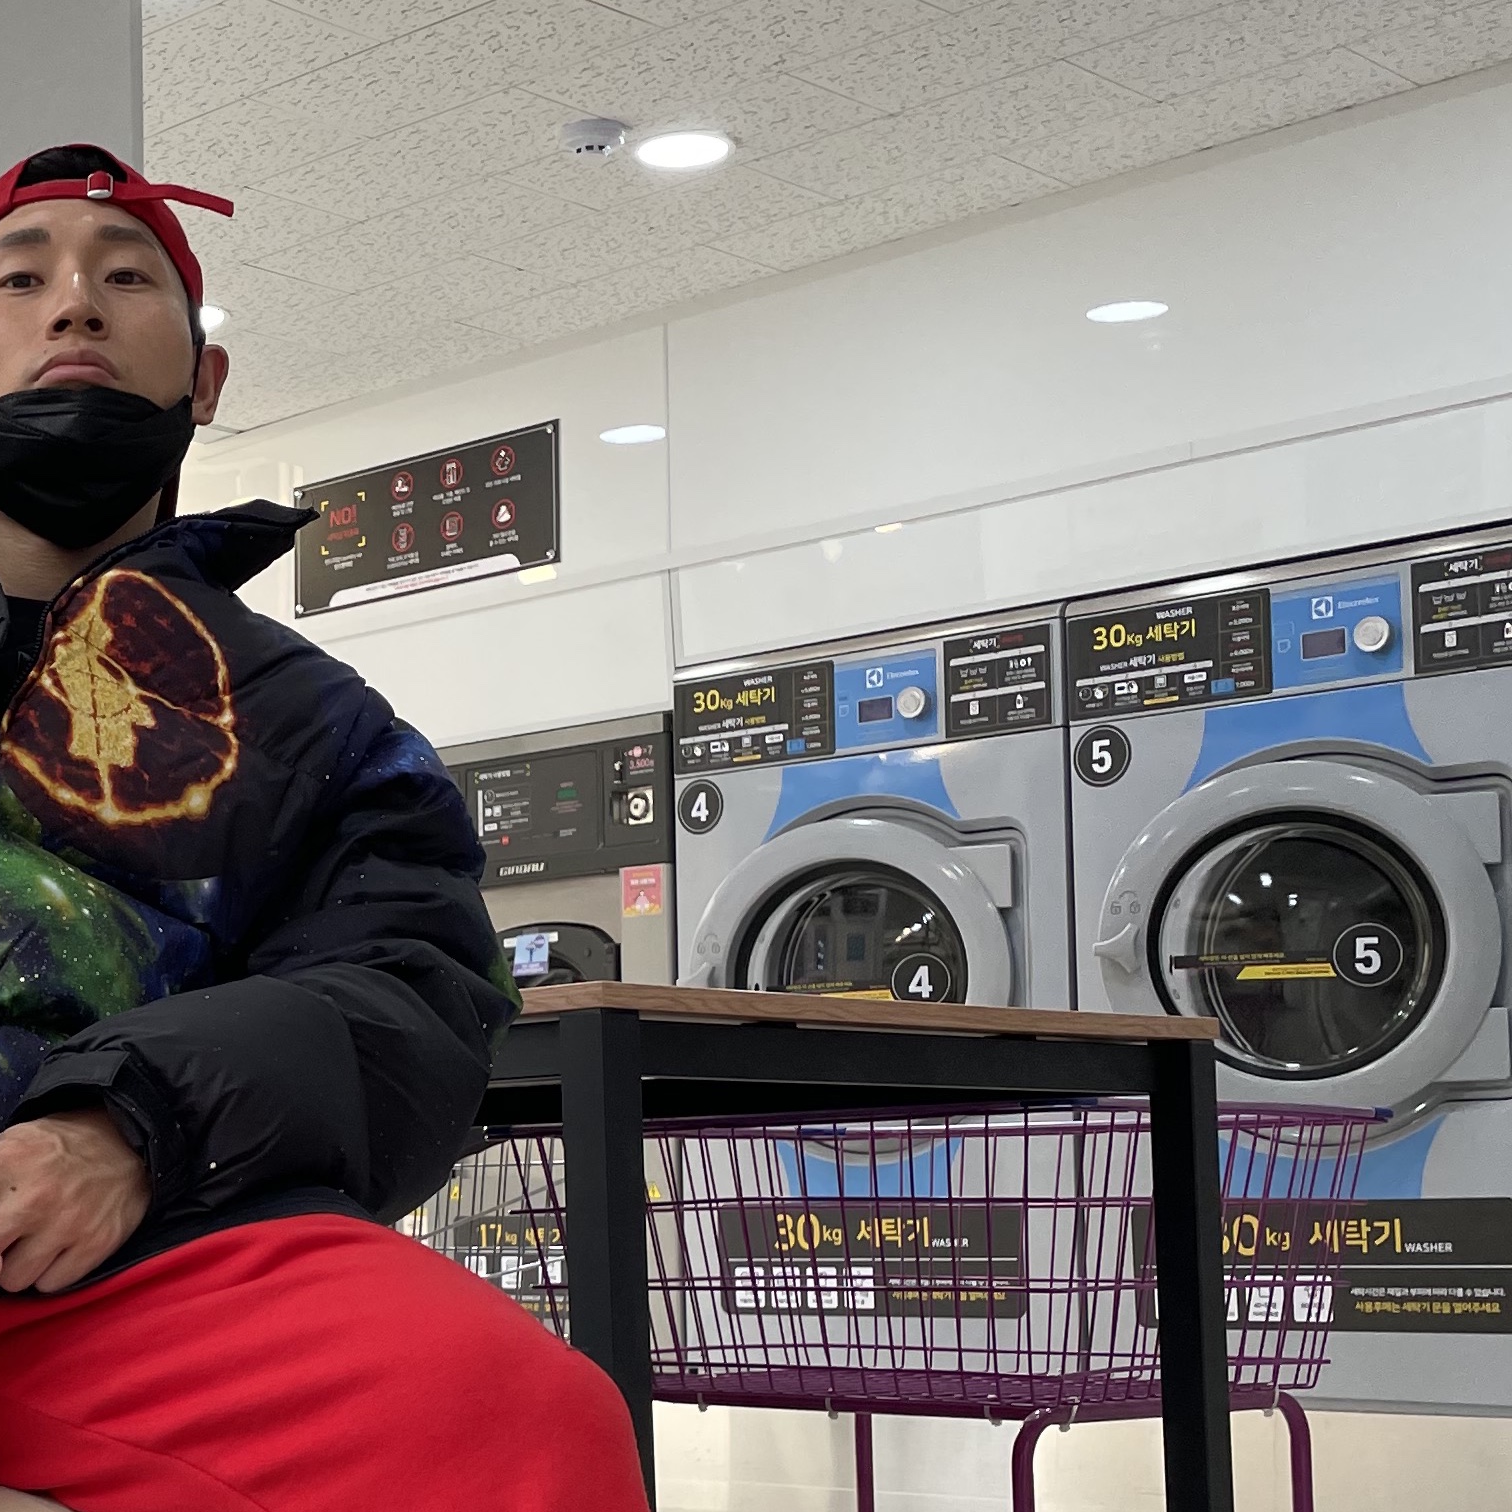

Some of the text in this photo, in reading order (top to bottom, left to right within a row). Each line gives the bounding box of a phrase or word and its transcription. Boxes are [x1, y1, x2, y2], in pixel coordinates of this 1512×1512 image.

[329, 503, 357, 529] NO!
[1449, 558, 1478, 573] 세탁기
[1155, 606, 1193, 620] WASHER
[1146, 618, 1197, 643] 세탁기
[1129, 653, 1156, 667] 세탁기
[743, 675, 773, 687] WASHER
[736, 686, 776, 707] 세탁기
[1091, 738, 1113, 773] 5
[691, 791, 710, 822] 4
[1354, 936, 1382, 975] 5
[908, 965, 934, 999] 4
[1308, 1217, 1402, 1254] 세탁기
[1404, 1242, 1453, 1254] WASHER
[1402, 1301, 1431, 1313] 세탁기
[1432, 1301, 1451, 1314] 문을
